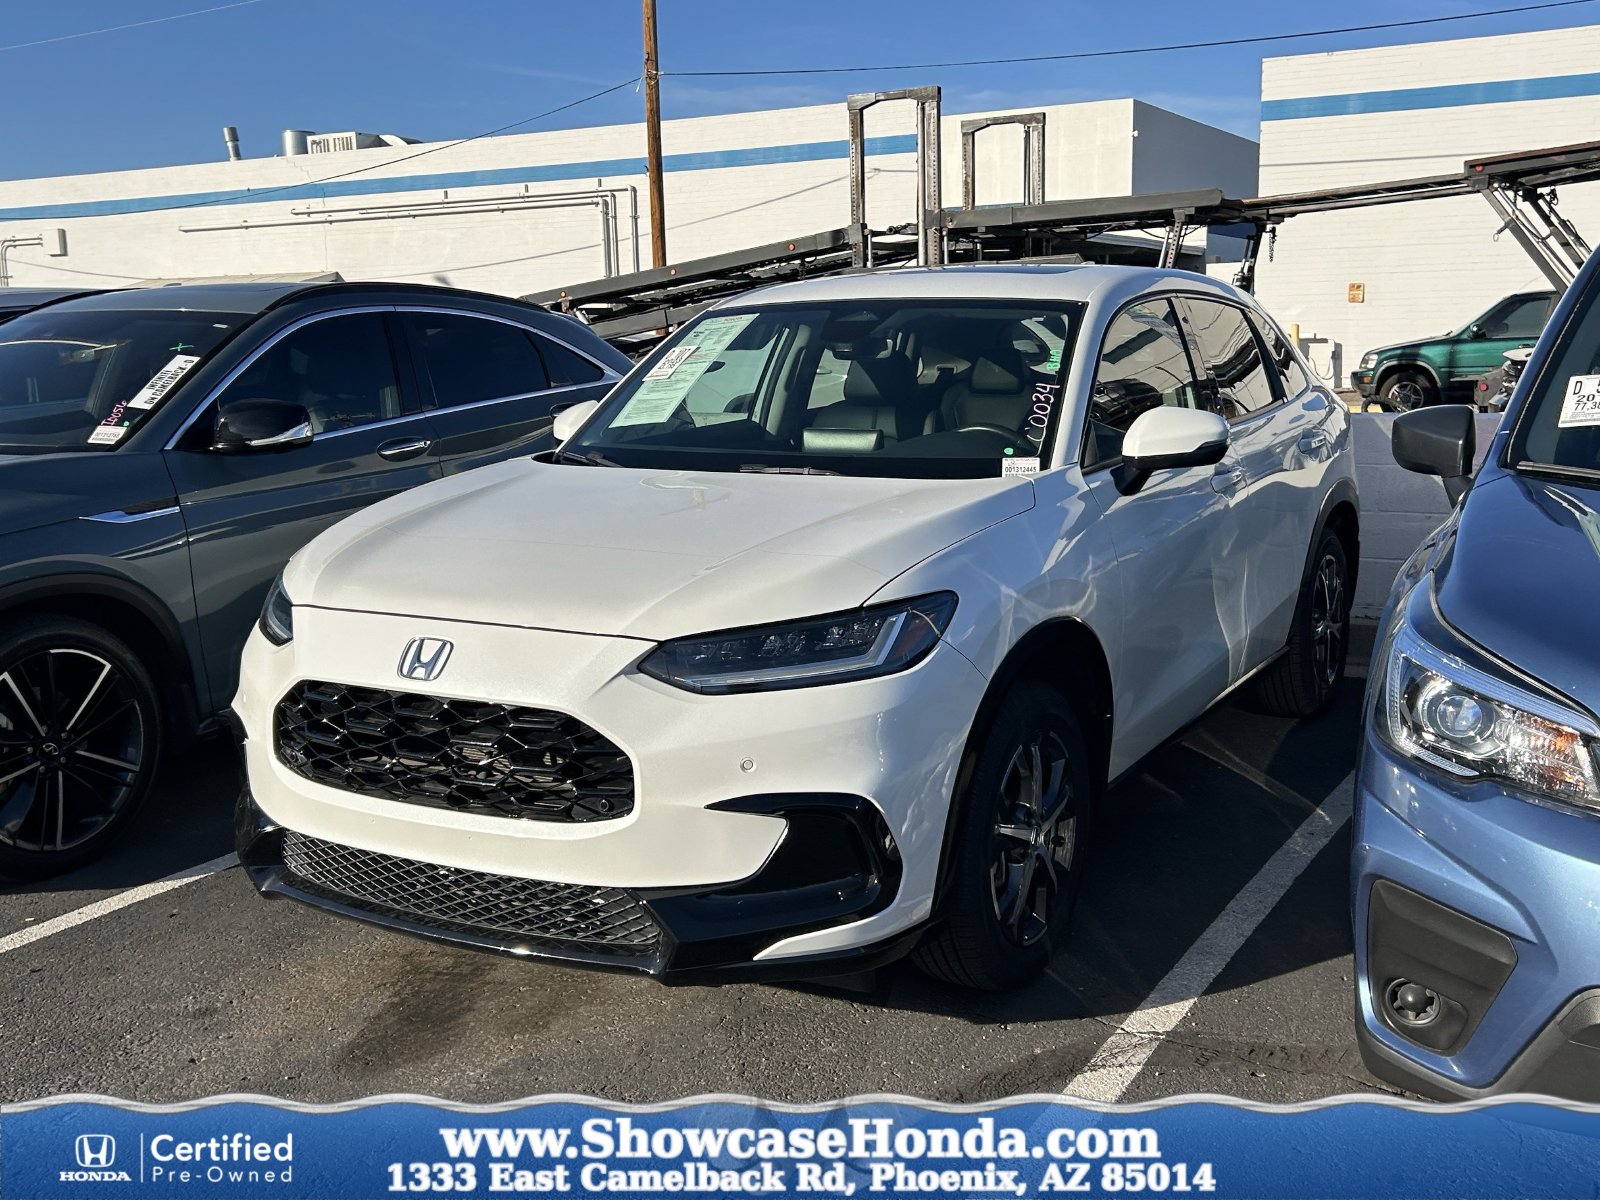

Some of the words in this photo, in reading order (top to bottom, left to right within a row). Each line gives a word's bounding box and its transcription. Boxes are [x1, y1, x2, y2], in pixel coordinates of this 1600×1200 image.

[146, 369, 172, 390] INFINITI
[152, 365, 186, 396] CAMELBACK
[1572, 381, 1583, 395] D
